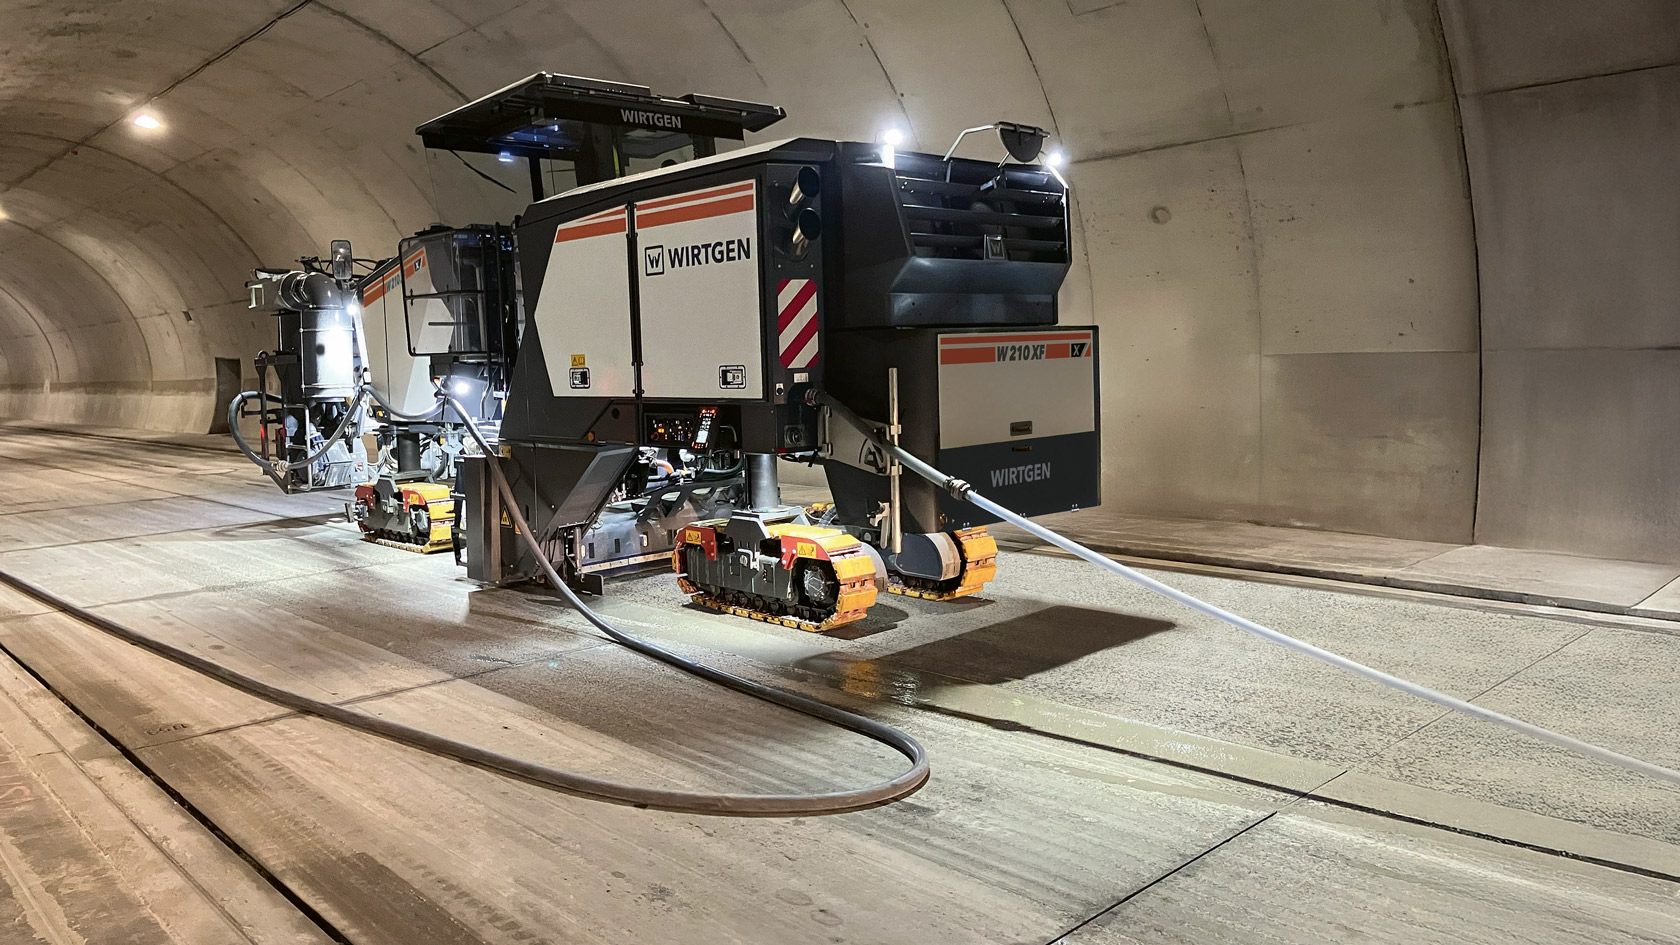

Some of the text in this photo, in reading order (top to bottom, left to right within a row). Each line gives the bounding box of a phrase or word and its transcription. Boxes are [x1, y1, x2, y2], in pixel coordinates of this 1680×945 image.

[620, 108, 682, 129] WIRTGEN
[667, 237, 751, 269] WIRTGEN
[990, 461, 1051, 488] WIRTGEN
